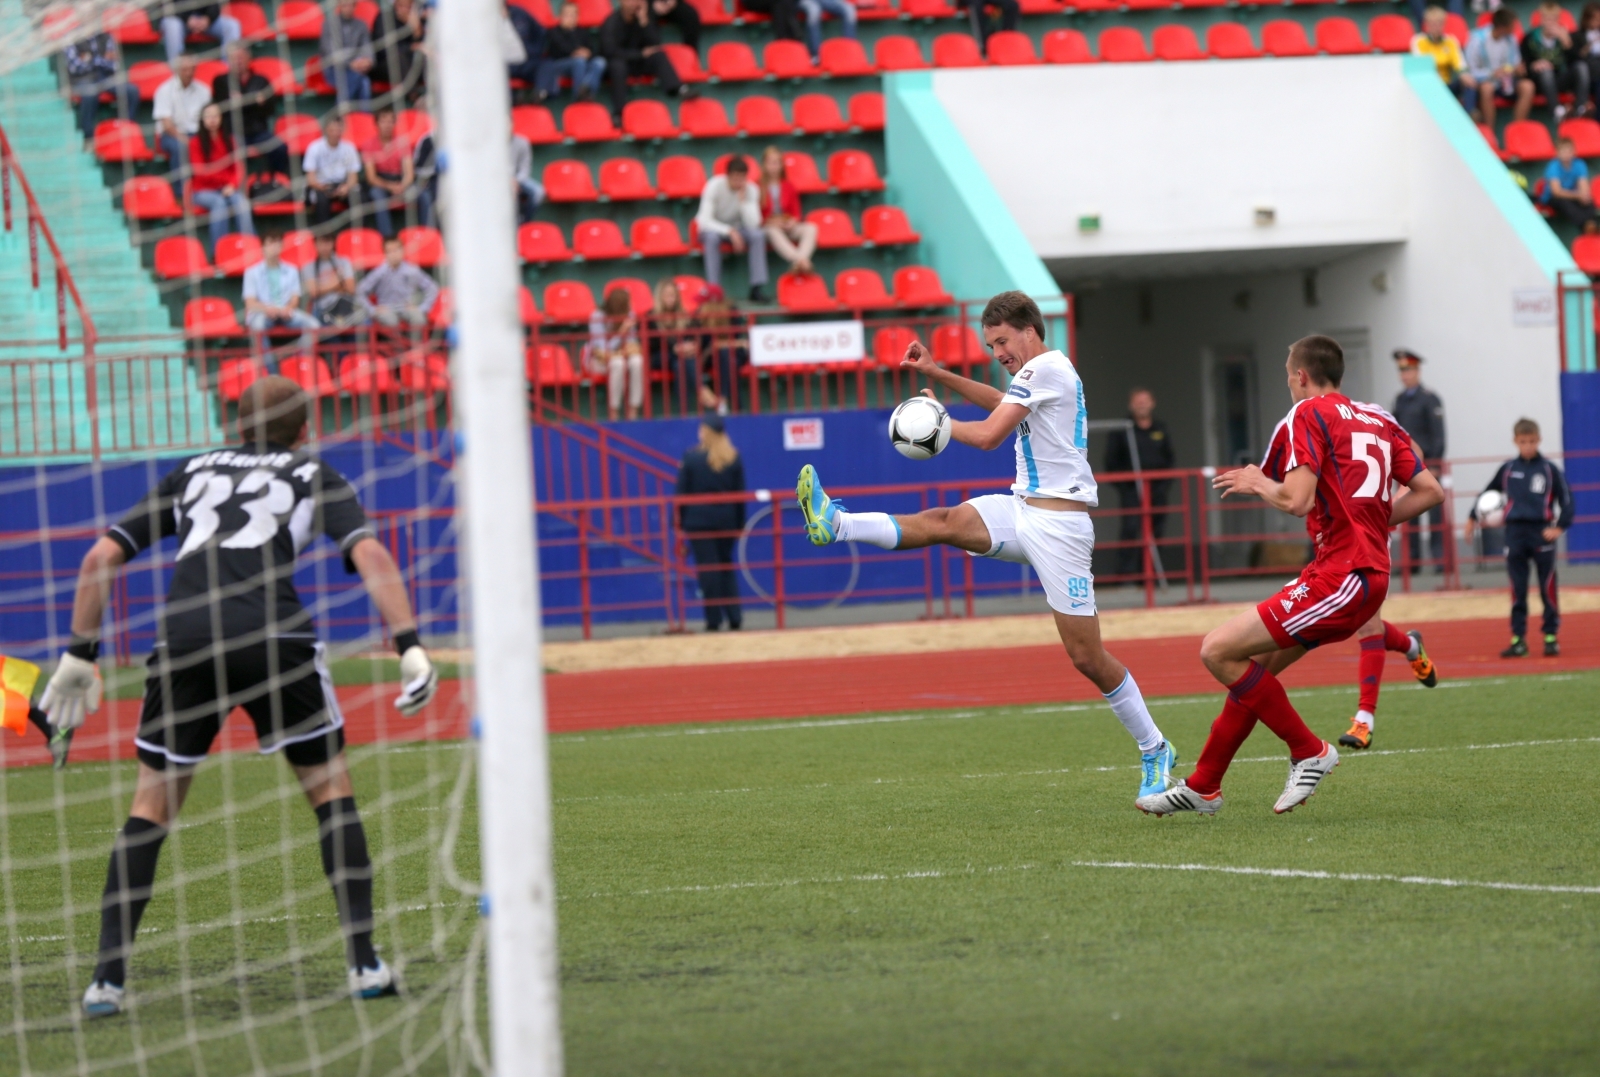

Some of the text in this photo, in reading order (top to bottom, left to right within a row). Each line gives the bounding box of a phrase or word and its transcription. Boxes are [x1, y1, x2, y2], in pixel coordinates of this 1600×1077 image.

[1351, 432, 1391, 502] 51
[175, 470, 295, 561] 33
[1068, 577, 1088, 598] 89
